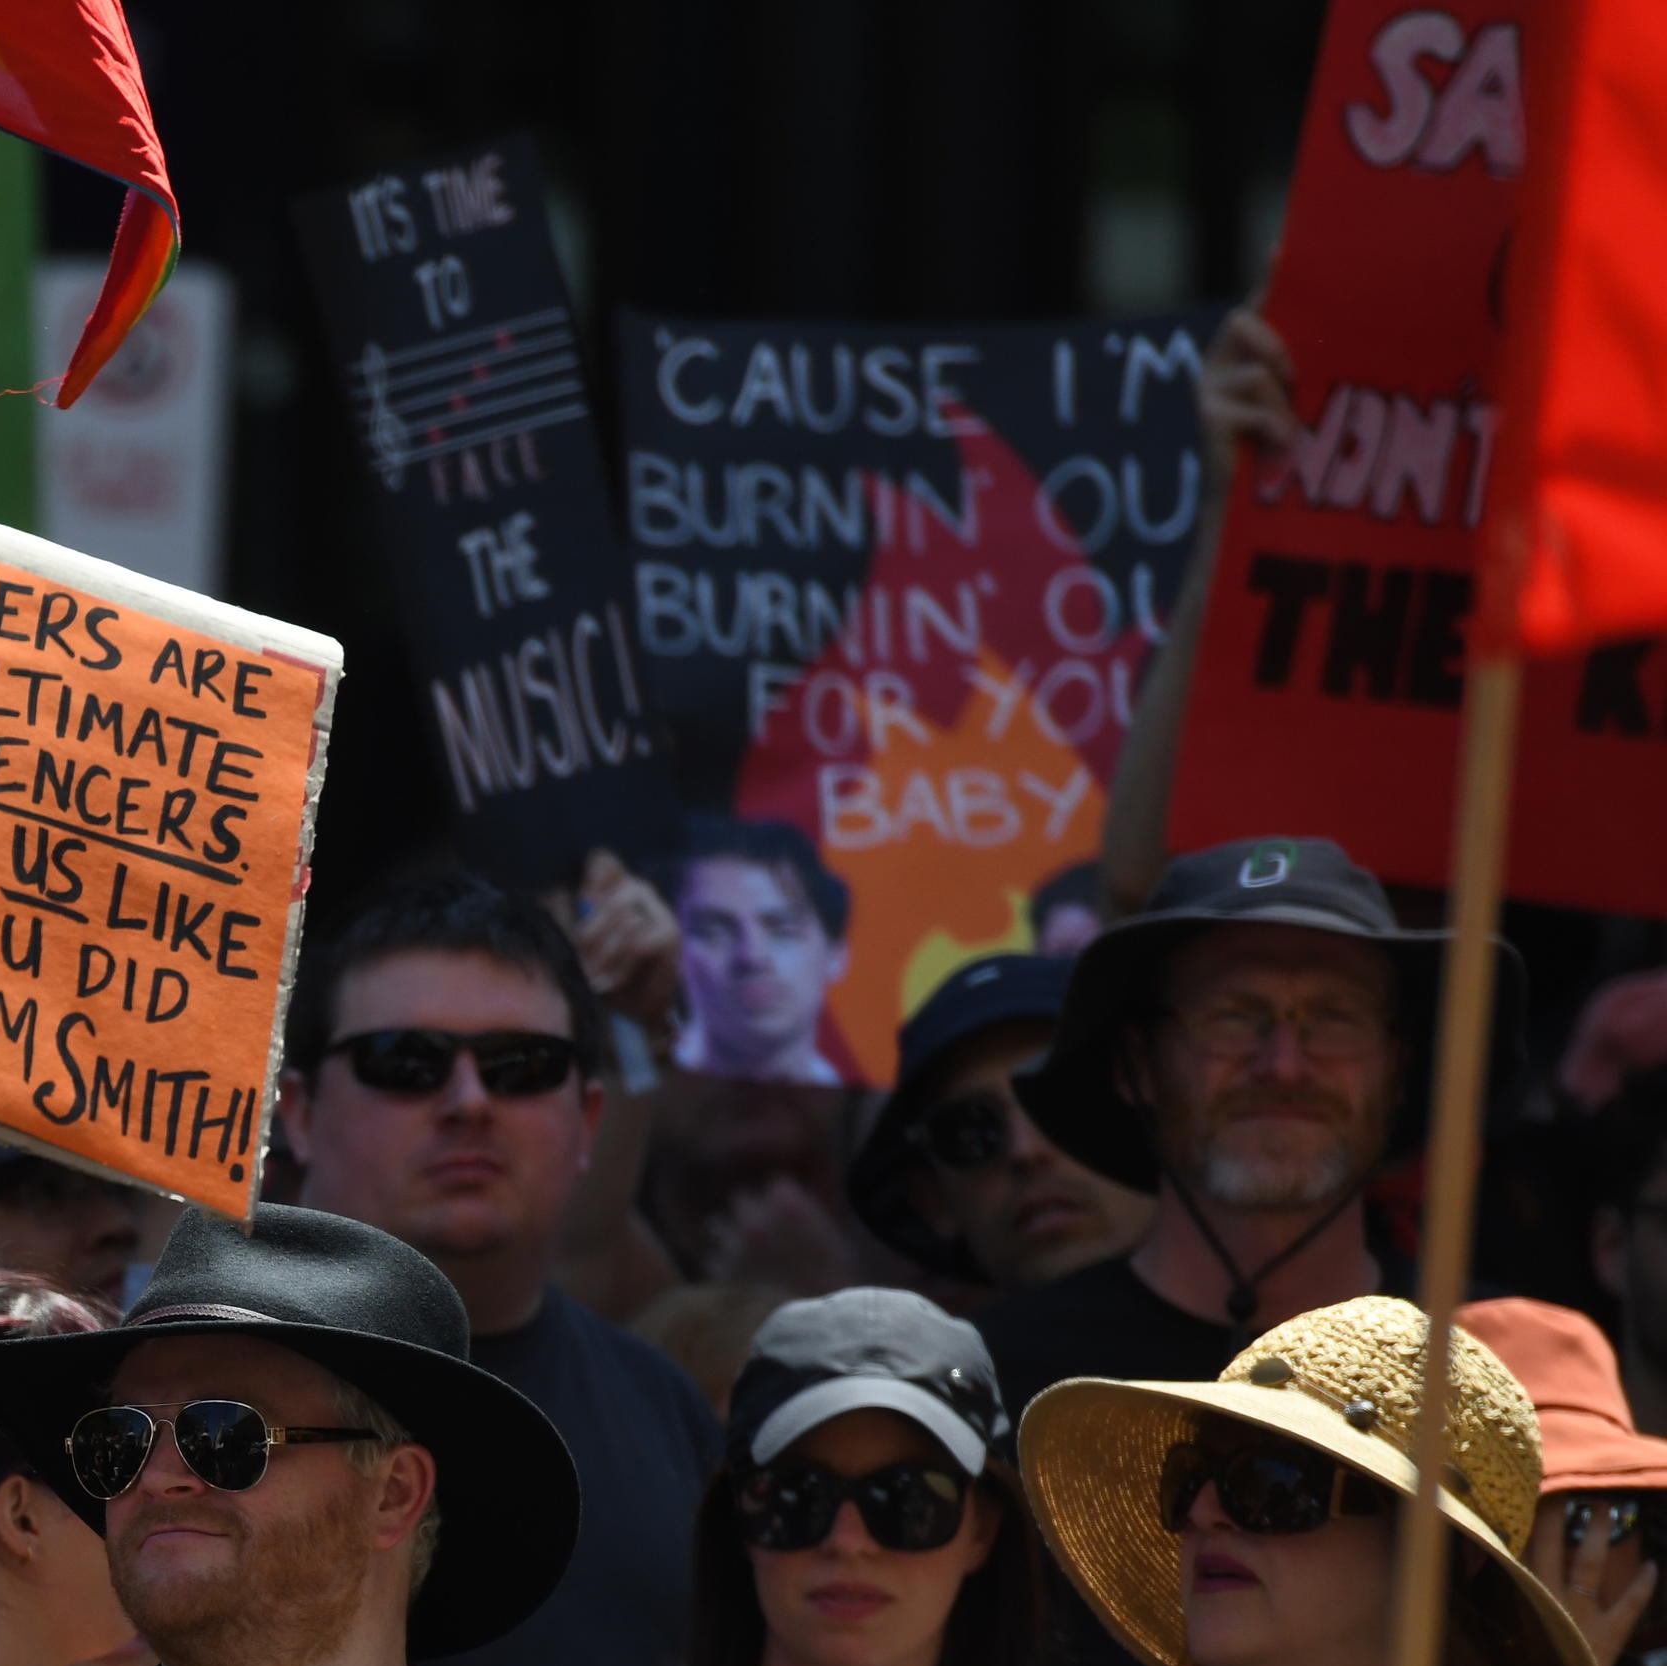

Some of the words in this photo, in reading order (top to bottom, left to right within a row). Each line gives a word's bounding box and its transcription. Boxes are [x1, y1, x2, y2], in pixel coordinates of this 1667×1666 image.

[421, 152, 515, 238] TIME
[413, 252, 473, 330] TO
[655, 328, 985, 438] 'CAUSE
[627, 448, 995, 554] BURNIN'
[458, 510, 551, 620] THE
[633, 560, 995, 666] BURNIN'
[149, 638, 273, 718] ARE
[1247, 552, 1477, 712] THE
[430, 600, 652, 812] MUSIC!
[747, 660, 931, 758] FOR
[815, 760, 1093, 850] BABY
[12, 825, 87, 903] US
[107, 862, 261, 980] LIKE
[77, 944, 189, 1023] DID
